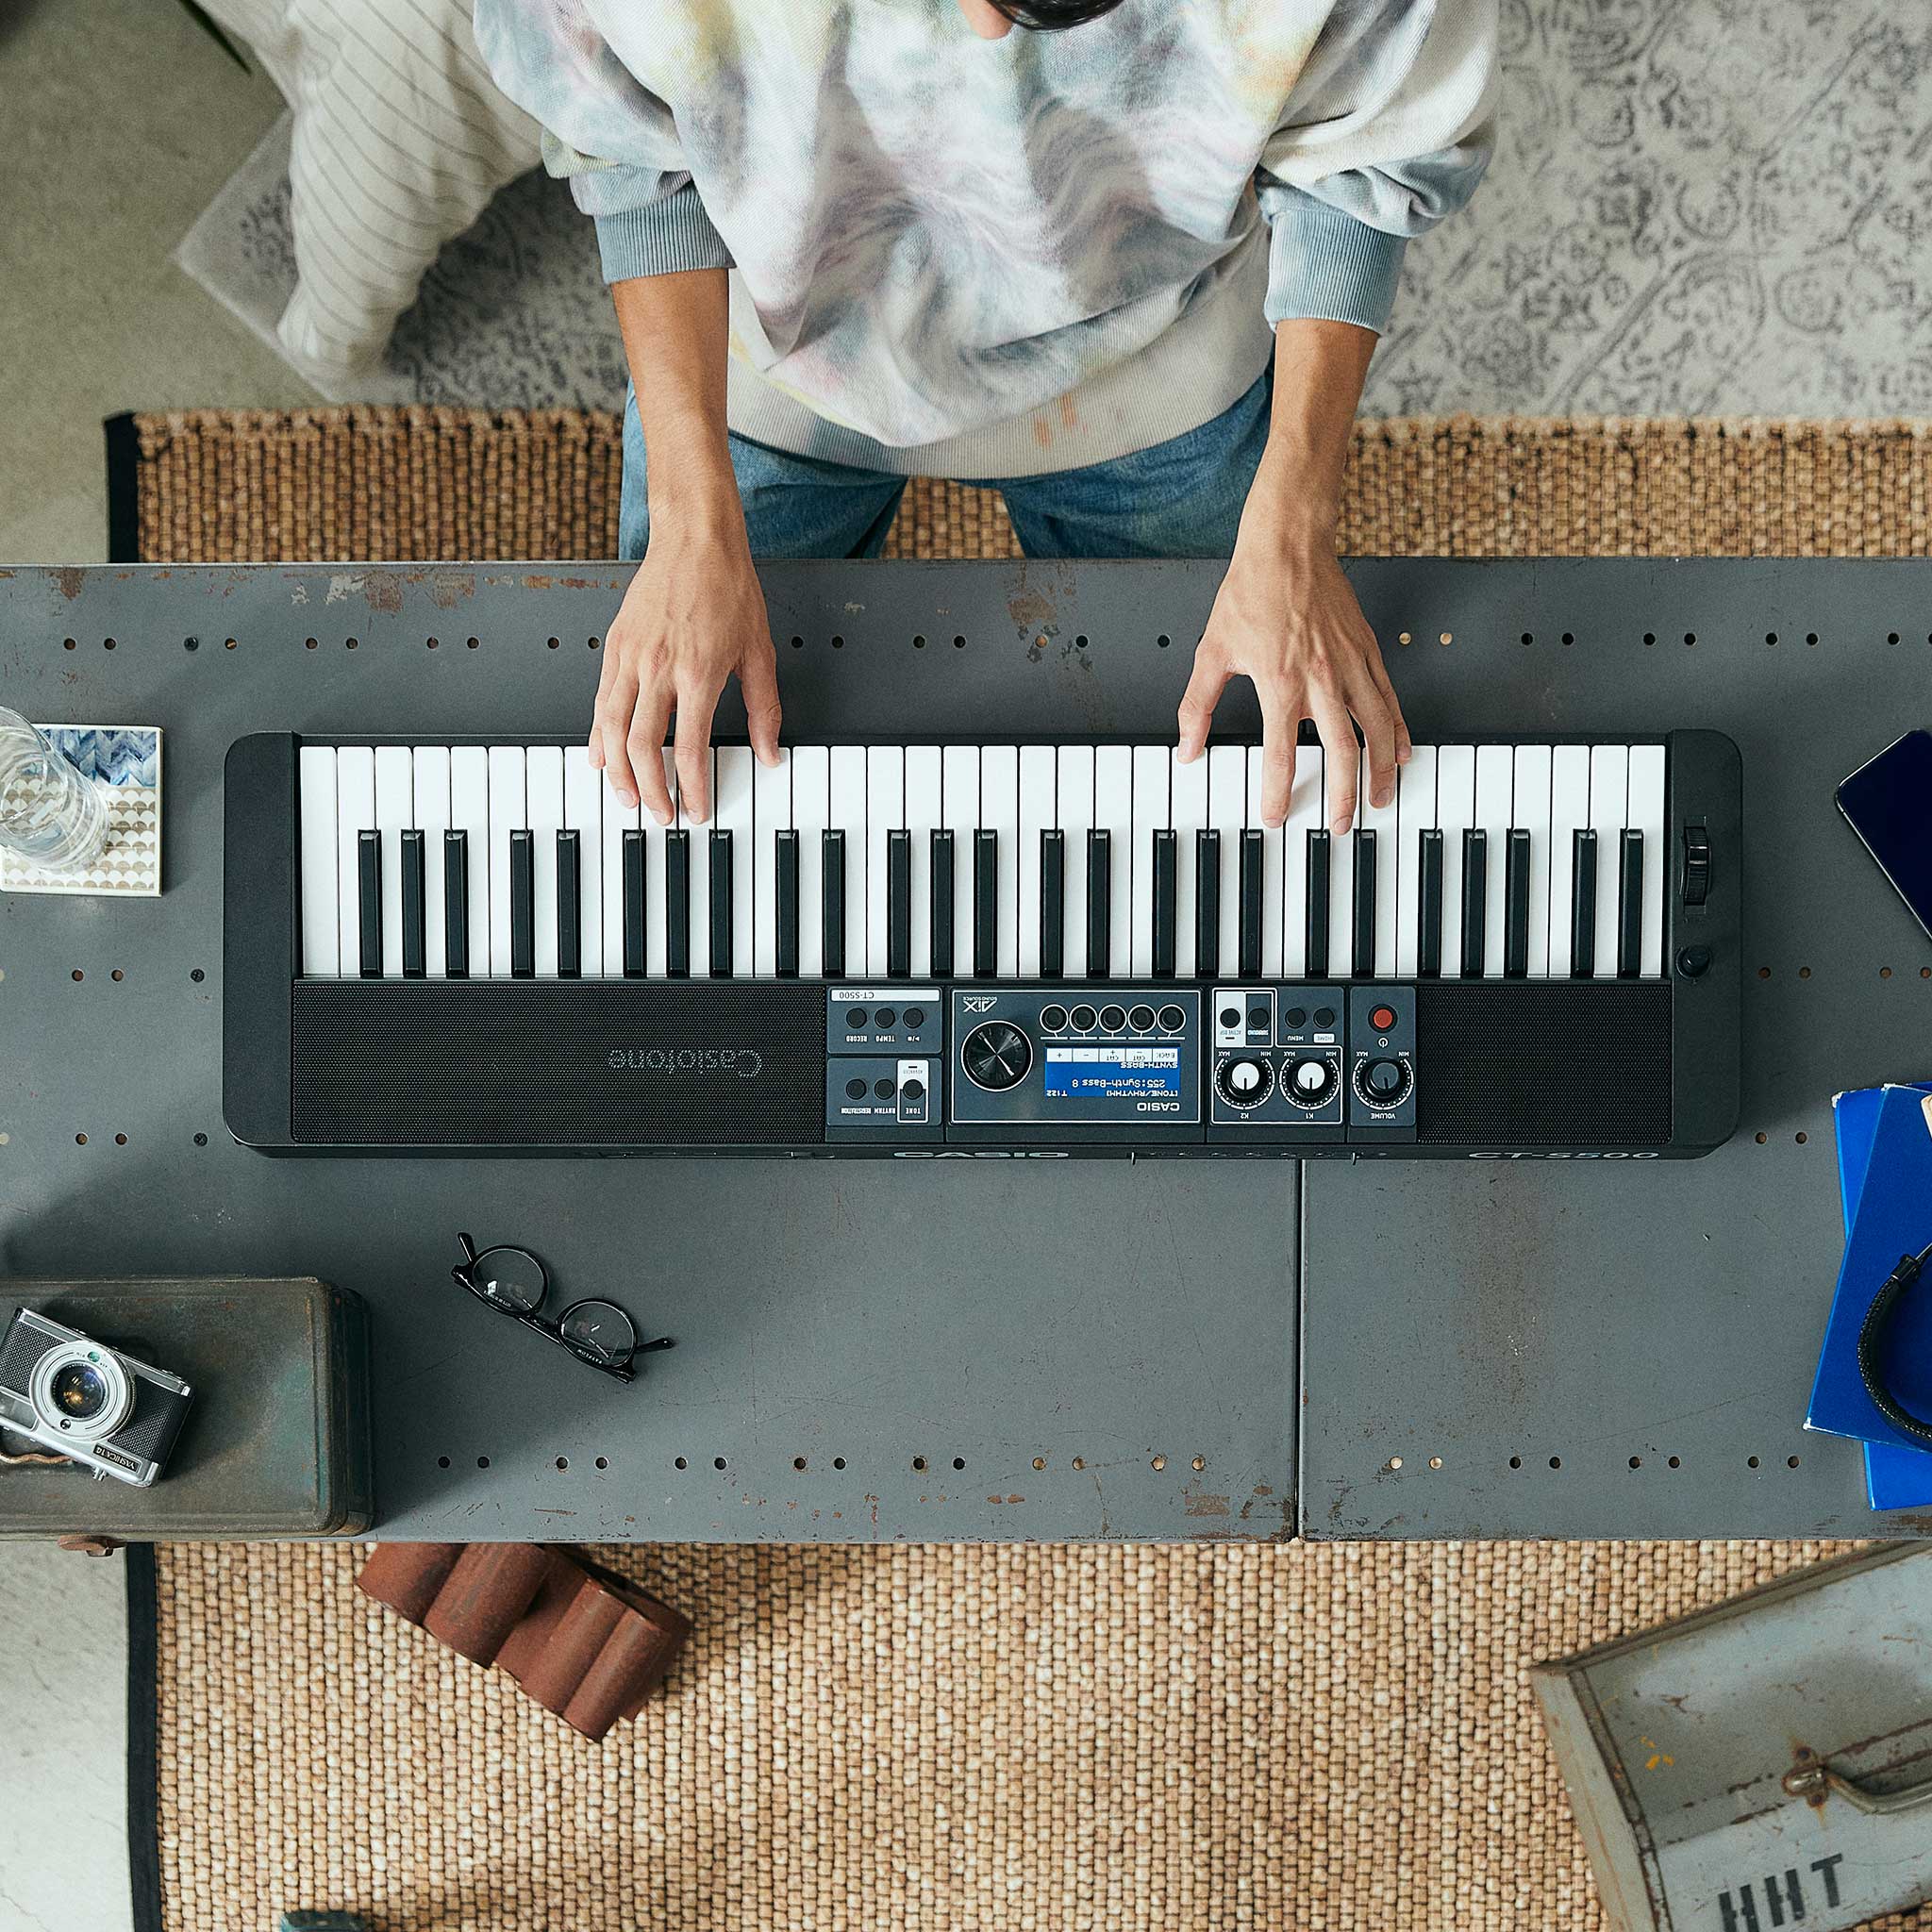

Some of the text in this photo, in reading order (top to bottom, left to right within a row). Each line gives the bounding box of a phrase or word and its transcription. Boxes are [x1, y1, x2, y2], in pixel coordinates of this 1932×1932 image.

[608, 1050, 762, 1077] Casiotone
[1072, 1079, 1078, 1088] 8
[1137, 1102, 1180, 1111] CASIO
[106, 1452, 136, 1470] YASHICA
